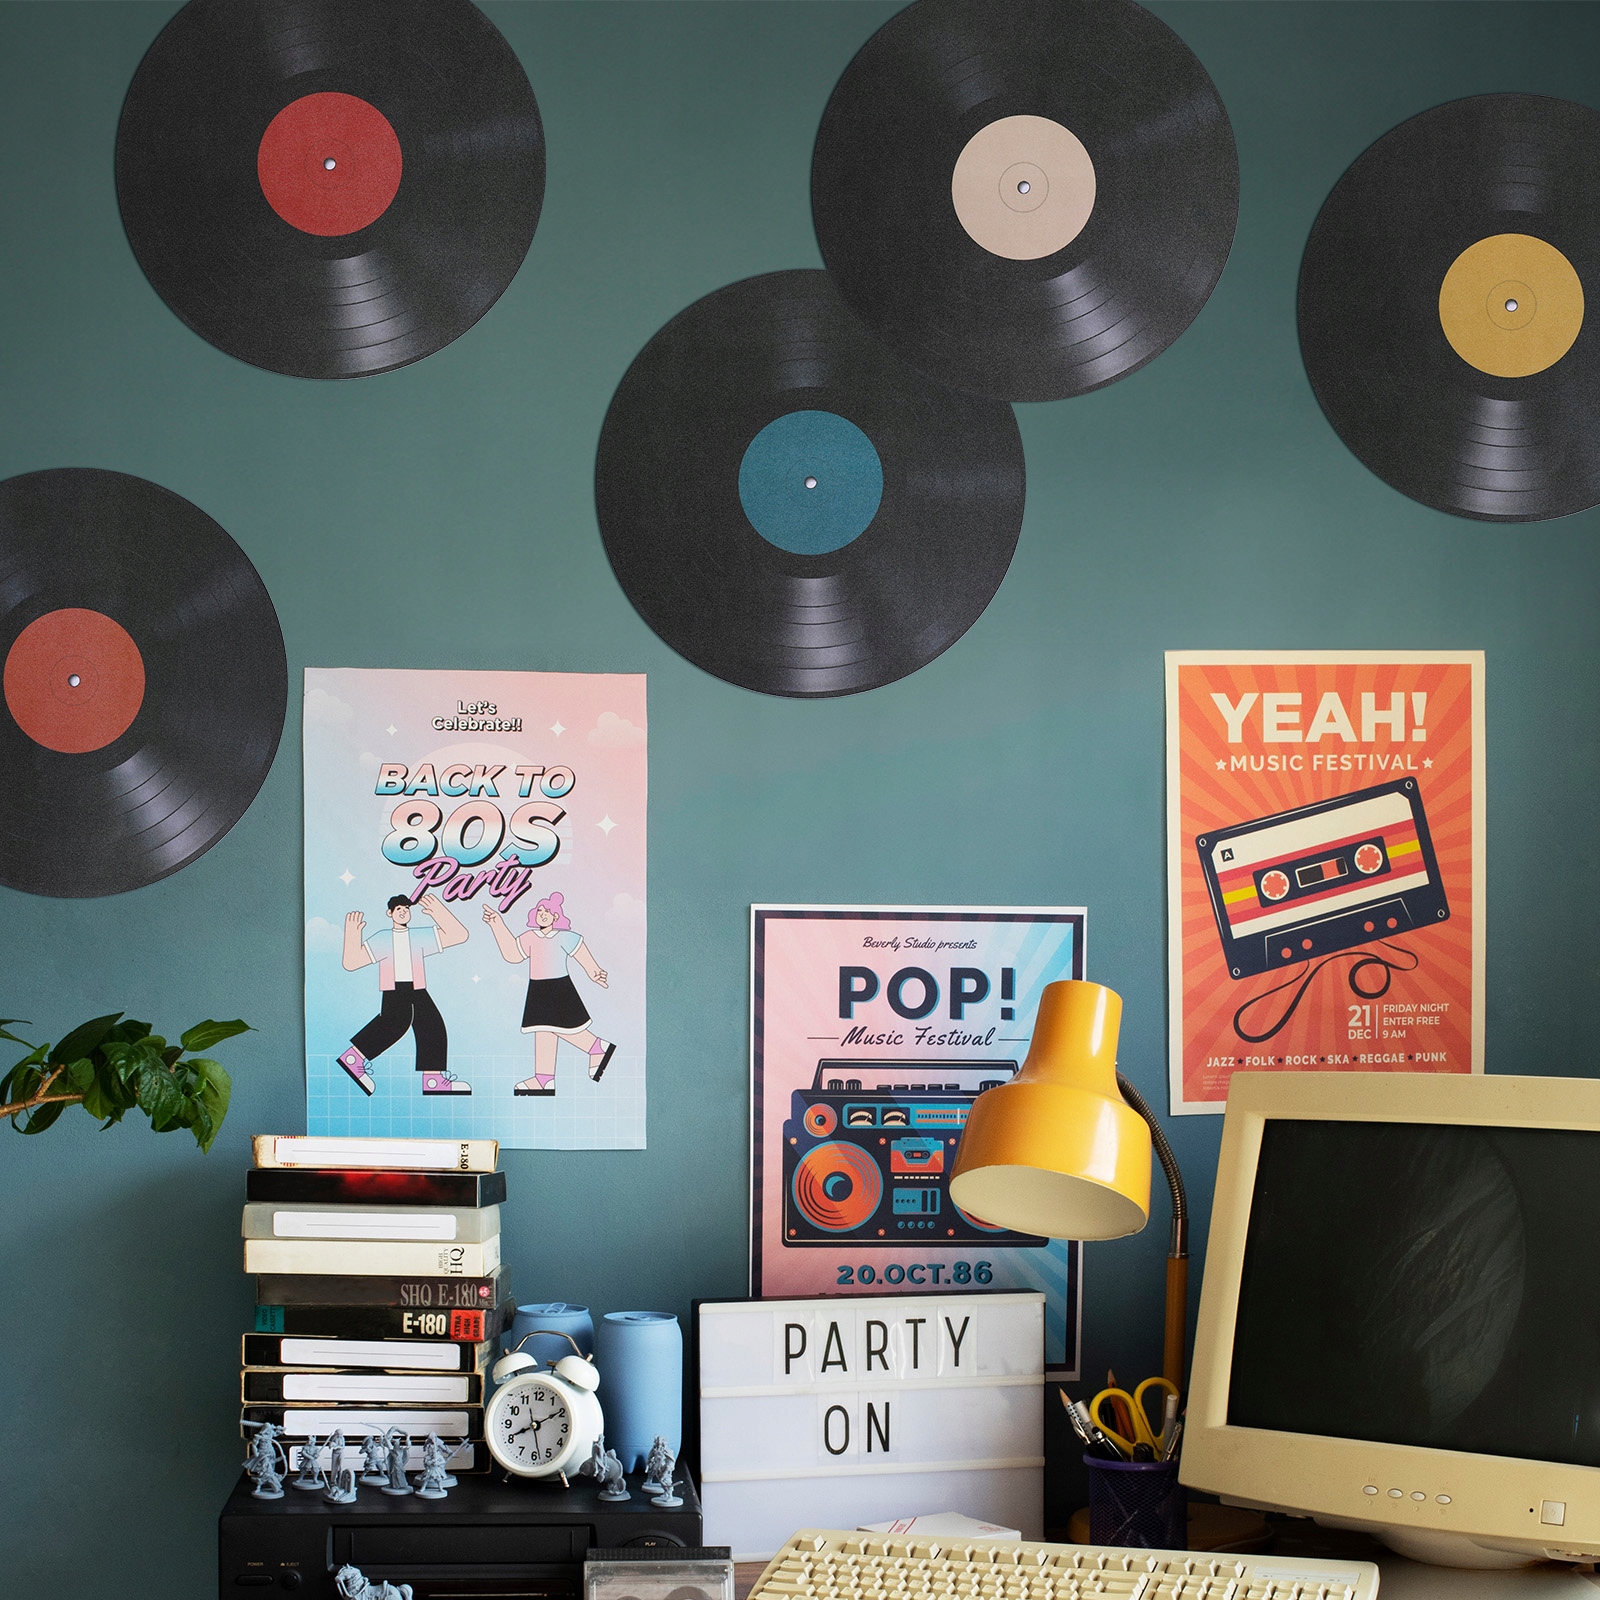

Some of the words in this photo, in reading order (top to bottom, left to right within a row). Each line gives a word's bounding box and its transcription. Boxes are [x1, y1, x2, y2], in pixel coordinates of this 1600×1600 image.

[431, 715, 523, 733] Celebrate!!
[1210, 691, 1428, 744] YEAH!
[1230, 754, 1304, 772] MUSIC
[1313, 754, 1418, 772] FESTIVAL
[374, 763, 507, 798] BACK
[515, 764, 576, 799] TO
[381, 799, 568, 868] 80S
[1224, 851, 1232, 860] A
[411, 854, 532, 912] Party
[862, 937, 901, 951] Beverly
[903, 938, 936, 950] Studio
[935, 938, 978, 951] presents
[838, 966, 1016, 1020] POP!
[1347, 1004, 1371, 1027] 21
[1383, 1003, 1419, 1013] FRIDAY
[1420, 1002, 1450, 1013] NIGHT
[1383, 1017, 1414, 1026] ENTER
[1416, 1016, 1441, 1026] FREE
[840, 1024, 905, 1048] Music
[914, 1025, 996, 1047] Festival
[1348, 1029, 1372, 1040] DEC
[1382, 1029, 1389, 1039] 9
[1390, 1029, 1407, 1039] AM
[1206, 1056, 1236, 1068] JAZZ
[1245, 1055, 1276, 1067] FOLK
[1285, 1054, 1318, 1066] ROCK
[1327, 1053, 1350, 1065] SKA
[1359, 1052, 1405, 1064] REGGAE
[1415, 1051, 1447, 1063] PUNK
[460, 1143, 469, 1170] E-180
[450, 1246, 465, 1274] HQ
[836, 1259, 994, 1286] 20.OCT.86
[400, 1283, 432, 1307] SHQ
[437, 1283, 478, 1307] E-180
[402, 1312, 447, 1336] E-180
[454, 1315, 462, 1337] EXTRA
[463, 1317, 471, 1335] HIGH
[473, 1315, 481, 1337] GRADE
[784, 1316, 970, 1375] PARTY
[520, 1394, 530, 1405] 11
[533, 1391, 545, 1401] 12
[550, 1396, 555, 1406] 1
[509, 1405, 520, 1417] 10
[558, 1407, 565, 1417] 2
[504, 1419, 513, 1429] 9
[561, 1423, 569, 1433] 3
[823, 1401, 891, 1456] ON
[507, 1434, 515, 1444] 8
[556, 1438, 564, 1447] 4
[518, 1446, 526, 1456] 7
[531, 1451, 538, 1461] 6
[545, 1448, 552, 1459] 5
